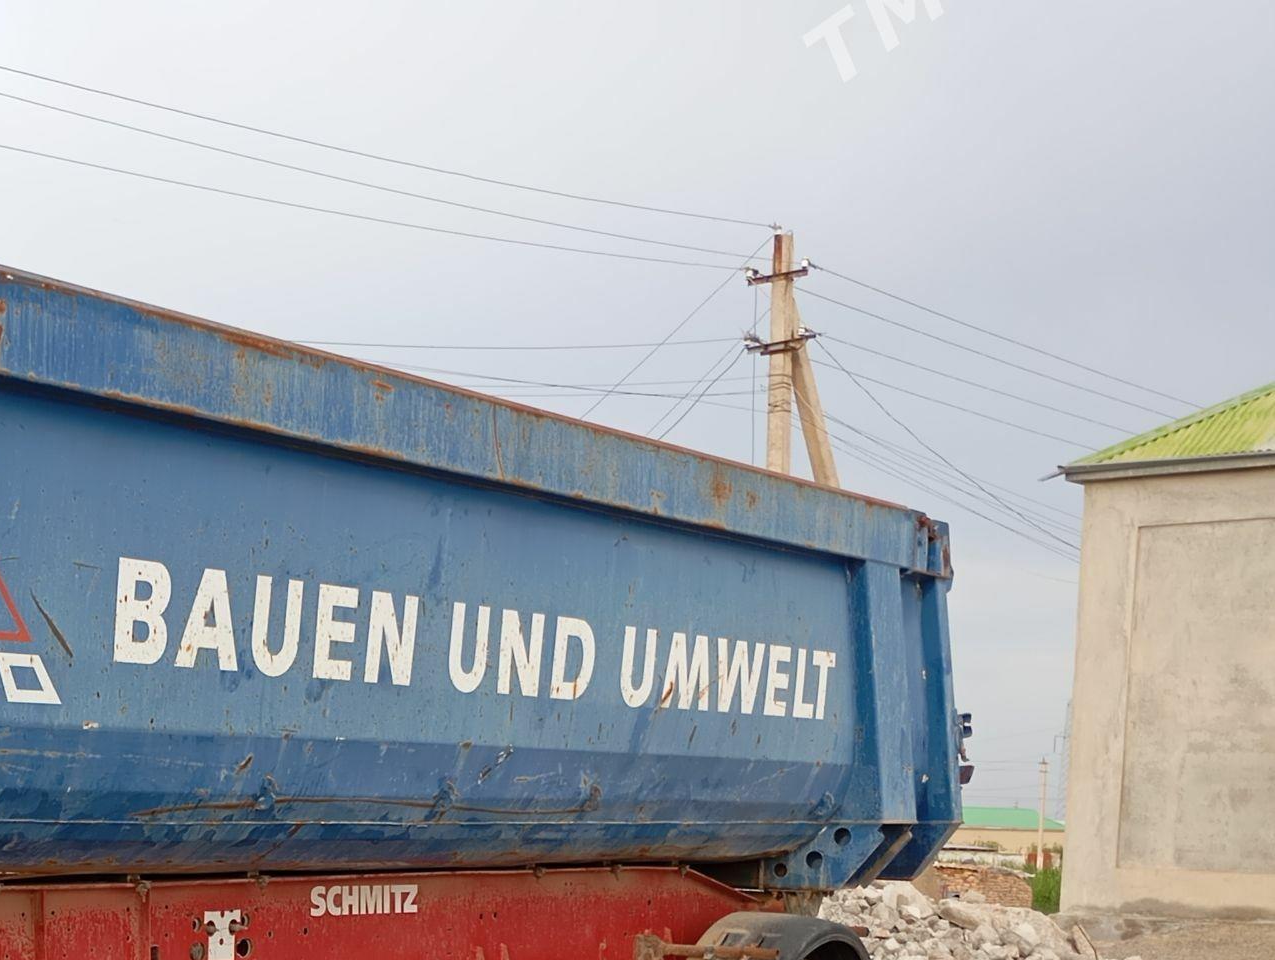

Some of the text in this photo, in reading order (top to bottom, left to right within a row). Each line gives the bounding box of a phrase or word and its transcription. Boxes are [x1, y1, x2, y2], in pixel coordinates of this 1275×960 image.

[112, 556, 837, 721] BAUEN UND UMWELT
[310, 884, 418, 917] SCHMITZ
